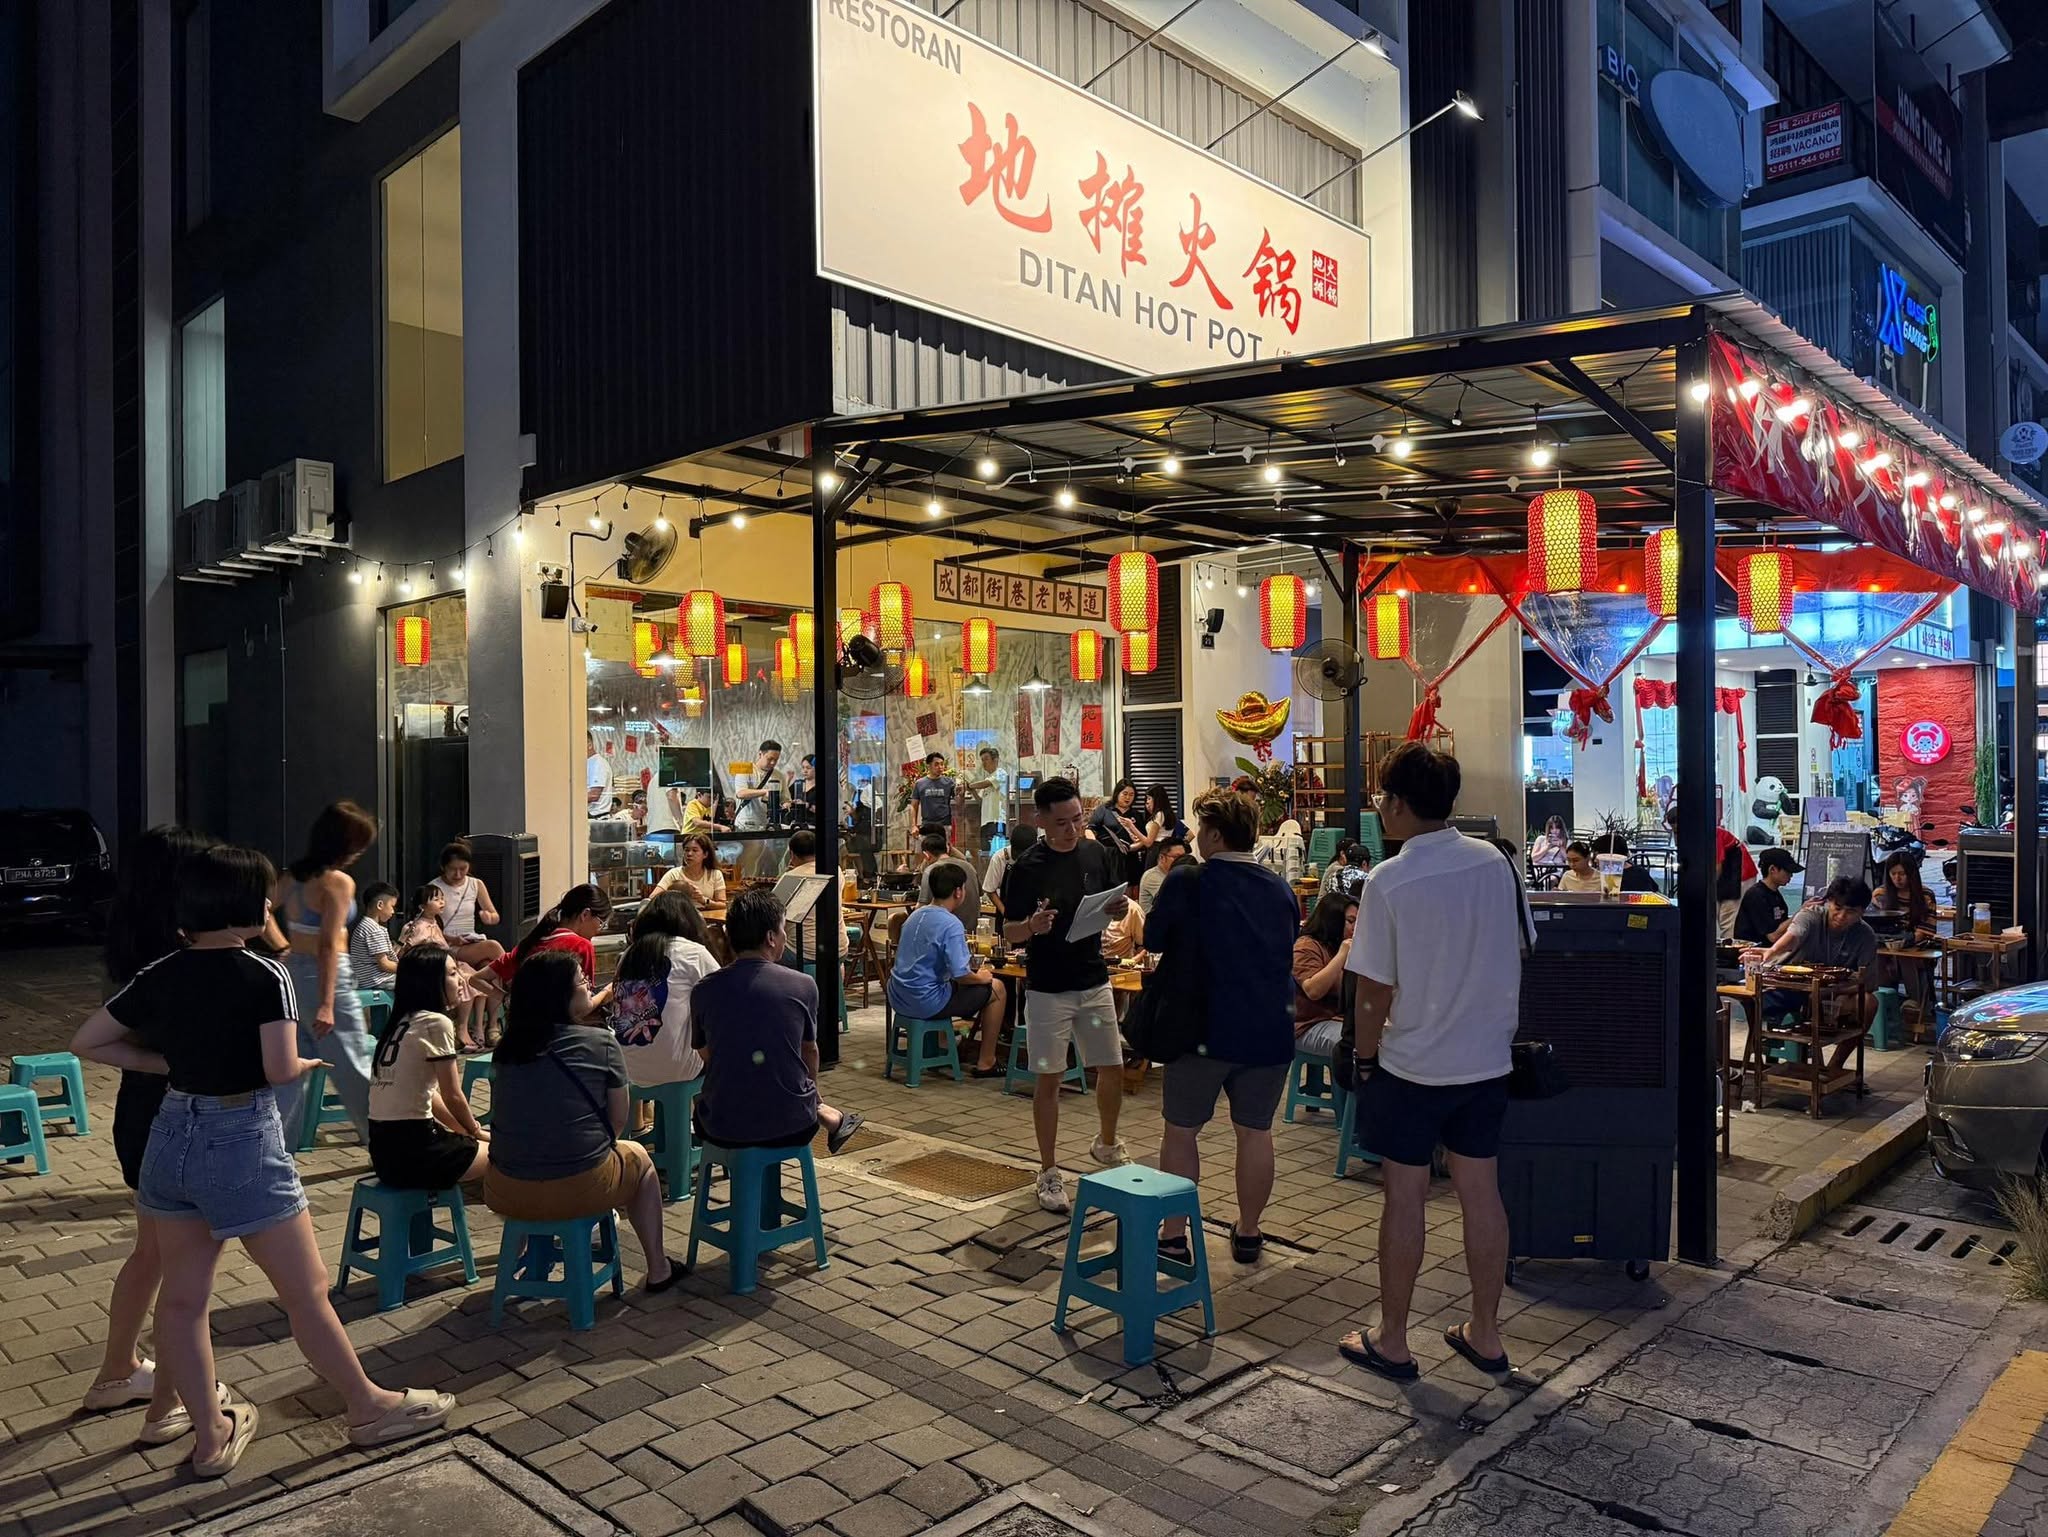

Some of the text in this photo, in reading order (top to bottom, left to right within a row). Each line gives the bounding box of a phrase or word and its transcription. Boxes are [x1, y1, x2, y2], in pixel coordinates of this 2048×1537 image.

[1791, 114, 1810, 127] 2nd
[1812, 107, 1838, 121] Floor
[1792, 131, 1840, 153] VACANCY
[957, 101, 1303, 336] 地摊火锅
[1020, 247, 1263, 361] DITAN HOT POT
[938, 569, 1100, 616] 成都街巷老味道
